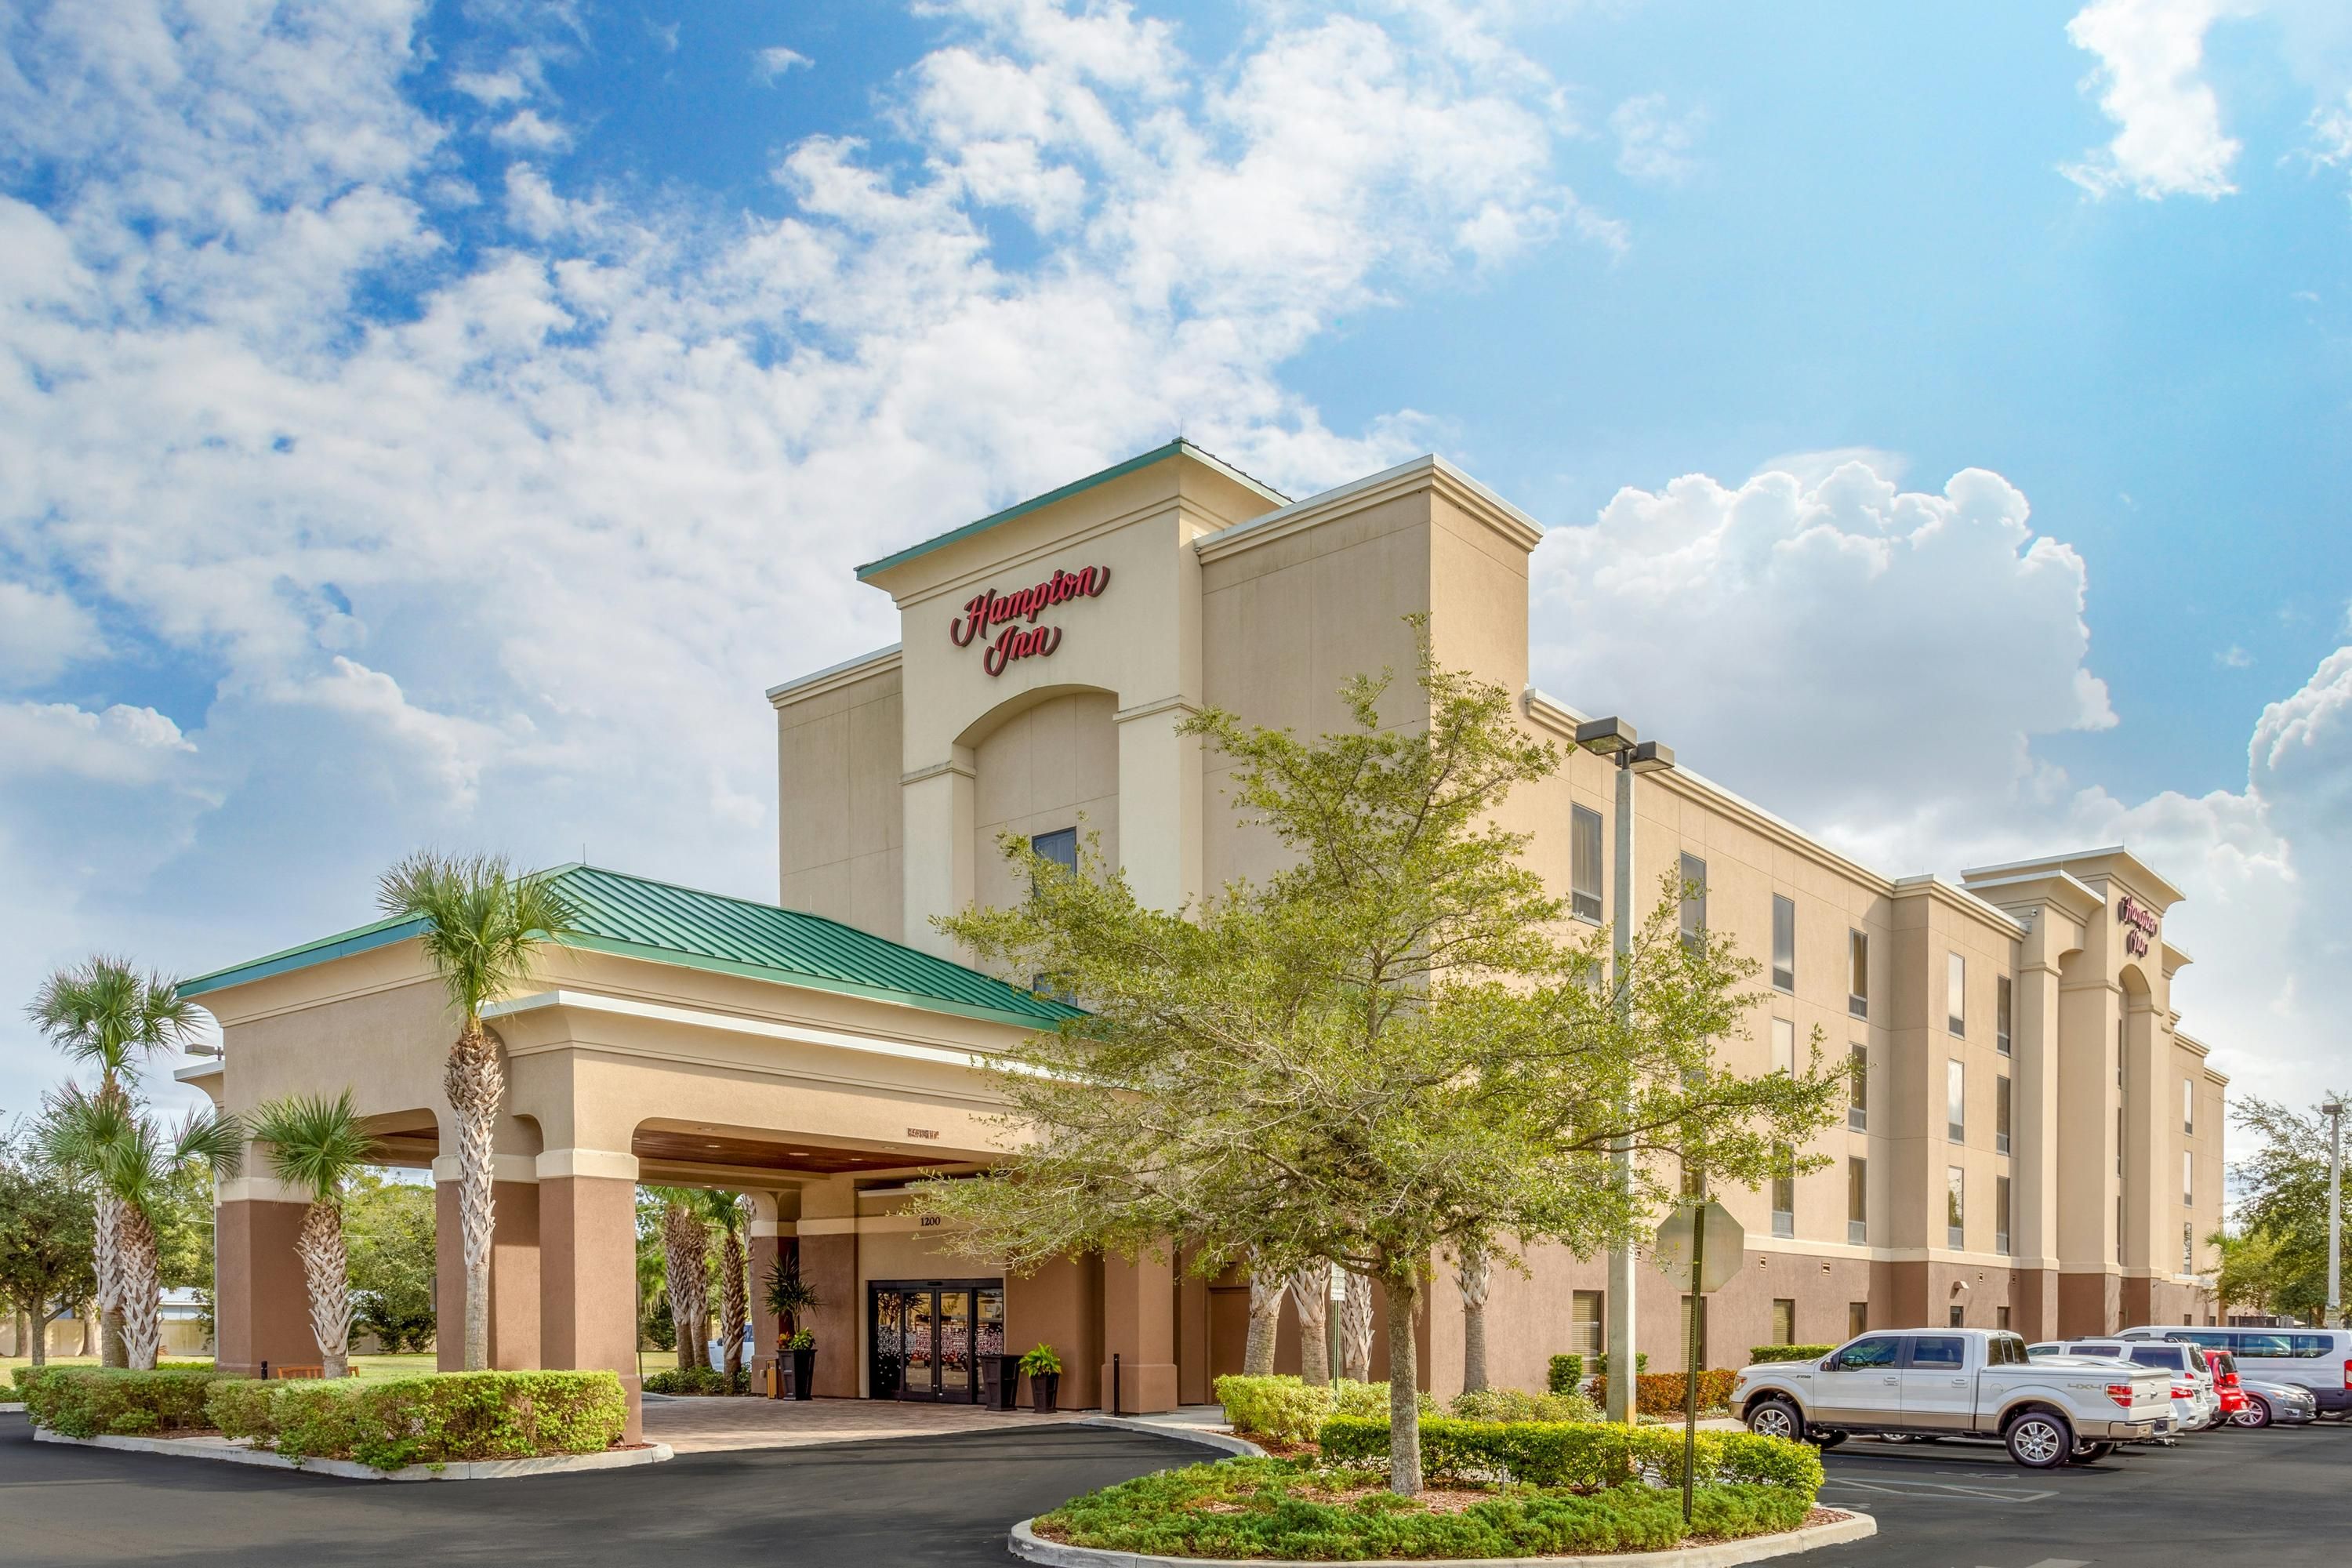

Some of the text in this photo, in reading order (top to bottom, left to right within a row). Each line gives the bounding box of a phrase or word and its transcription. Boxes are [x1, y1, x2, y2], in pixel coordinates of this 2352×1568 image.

[950, 565, 1111, 648] Hampton
[983, 626, 1062, 677] Inn
[920, 1217, 941, 1226] 1200
